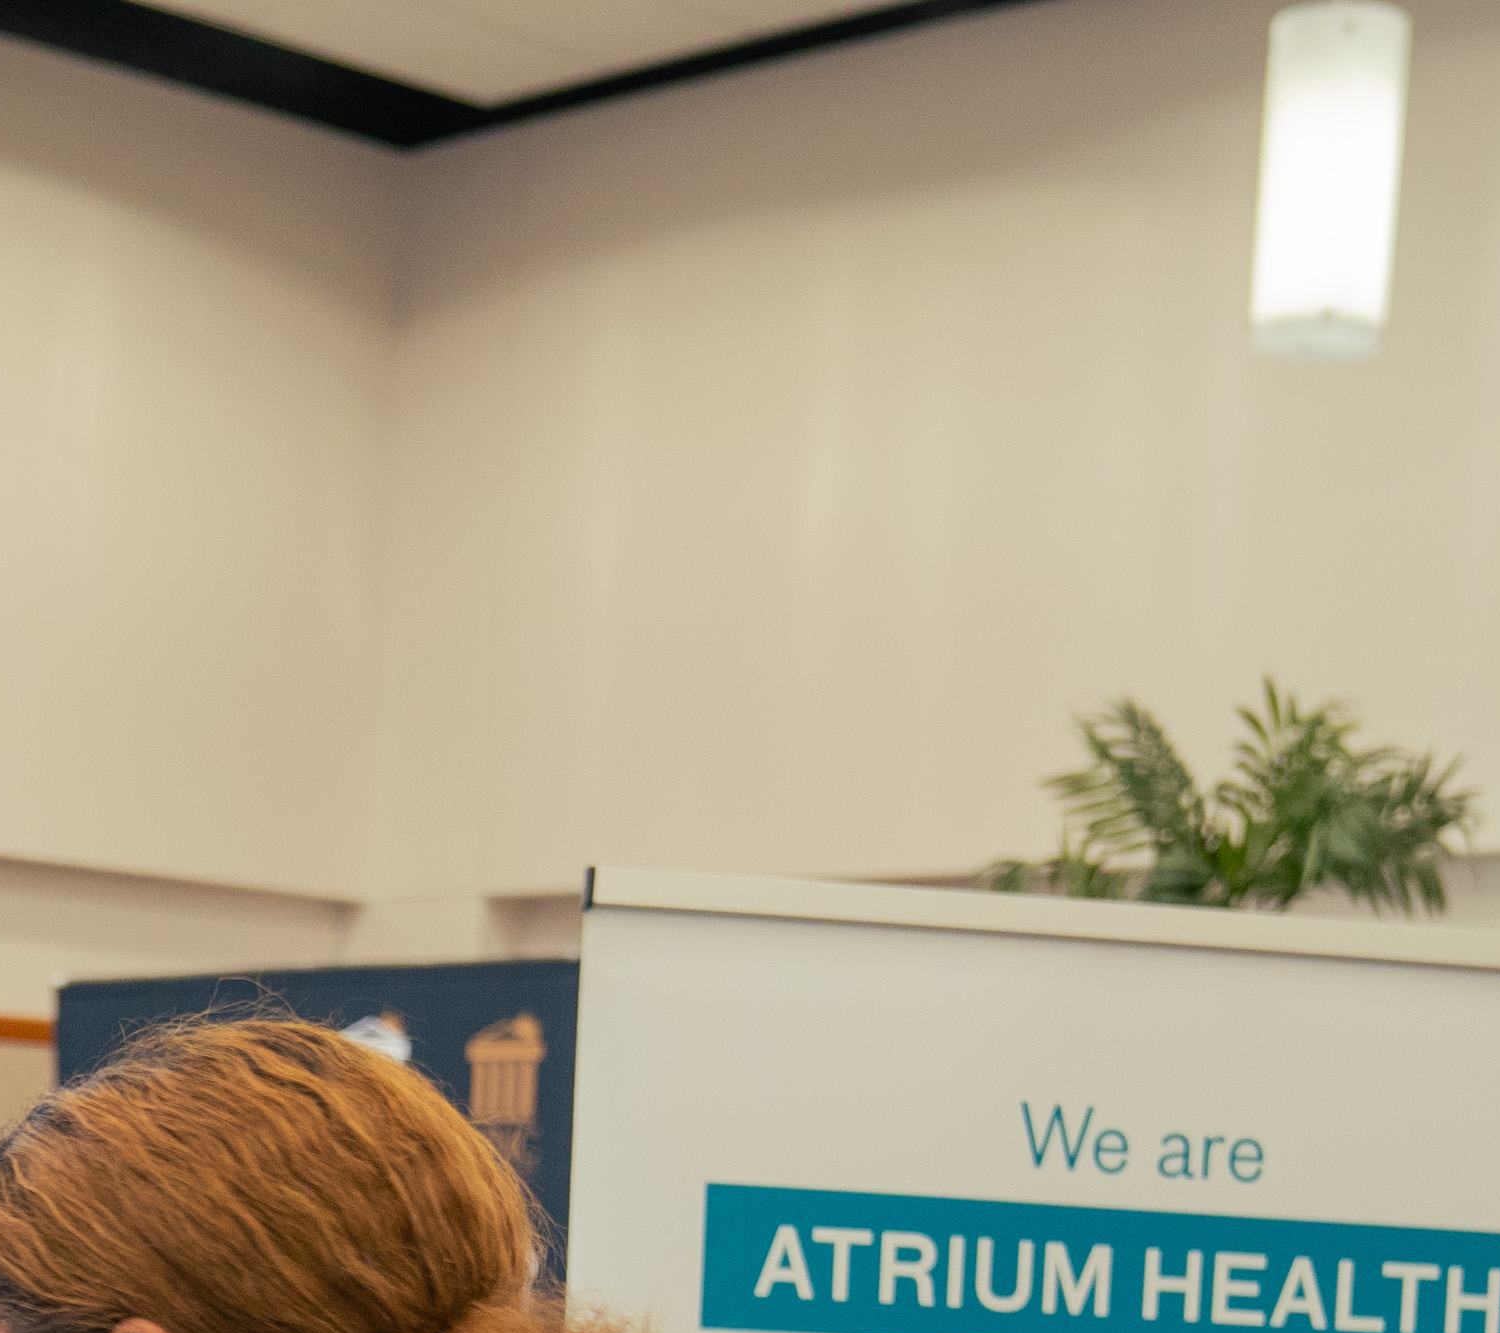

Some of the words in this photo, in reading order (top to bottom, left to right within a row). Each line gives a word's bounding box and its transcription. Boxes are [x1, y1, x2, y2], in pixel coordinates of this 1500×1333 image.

[1020, 1101, 1129, 1175] We
[1156, 1131, 1265, 1184] are
[753, 1223, 1114, 1319] ATRIUM
